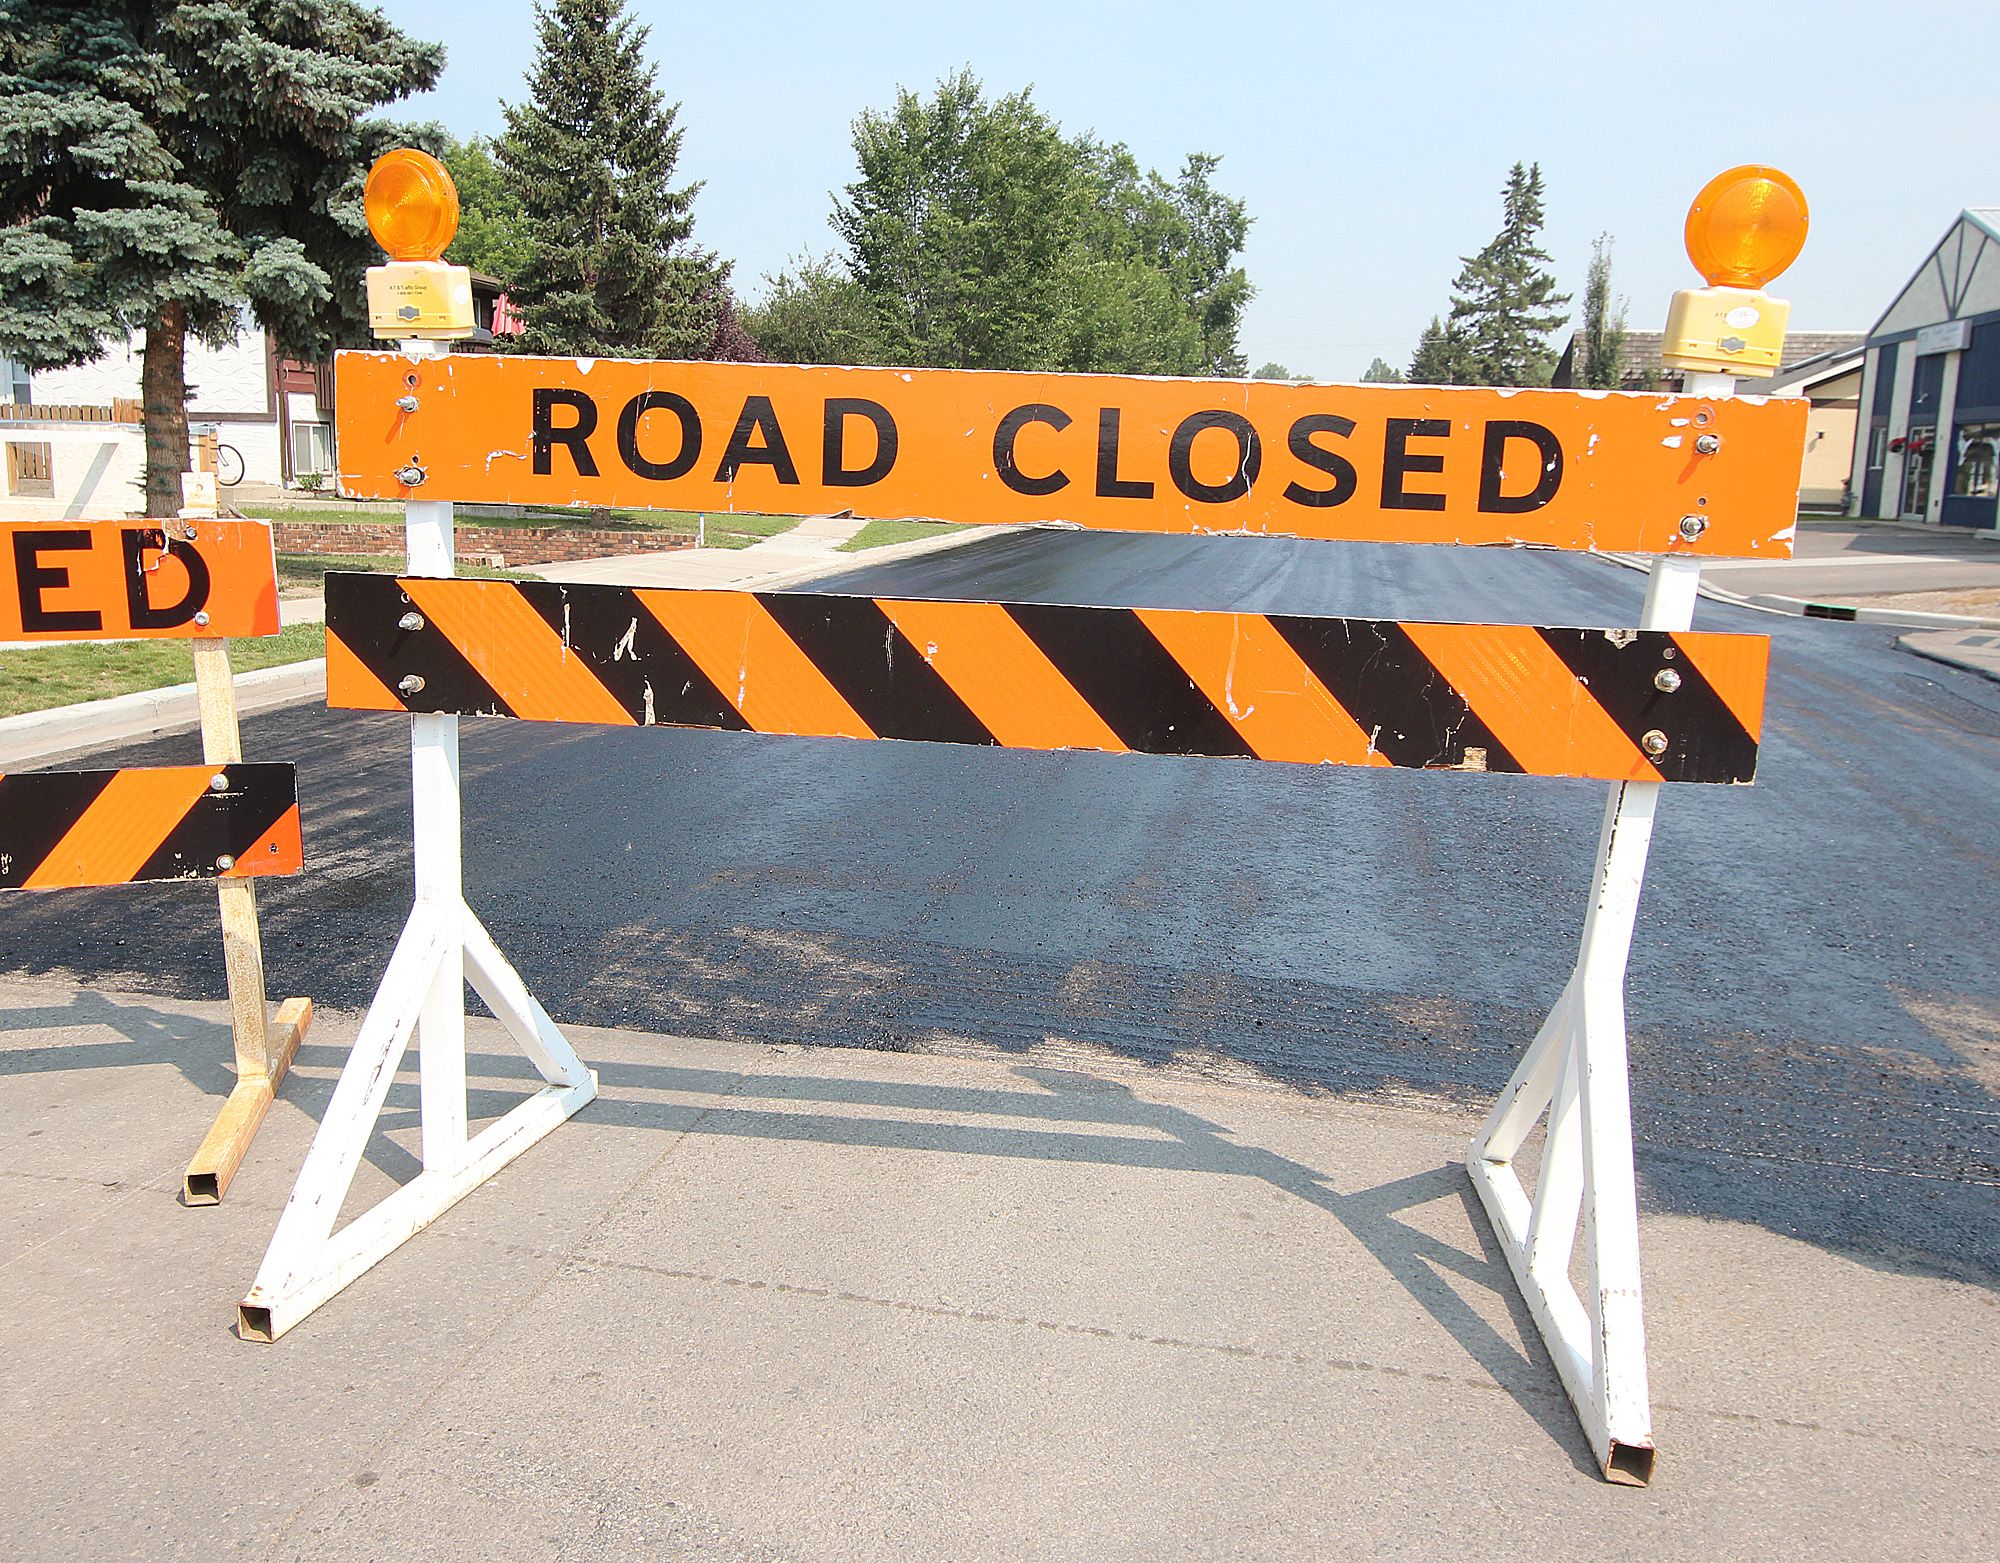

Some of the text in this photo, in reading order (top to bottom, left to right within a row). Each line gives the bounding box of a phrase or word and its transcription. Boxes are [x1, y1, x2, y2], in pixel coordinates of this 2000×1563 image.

[532, 387, 1564, 514] ROAD CLOSED
[12, 529, 210, 633] ED
